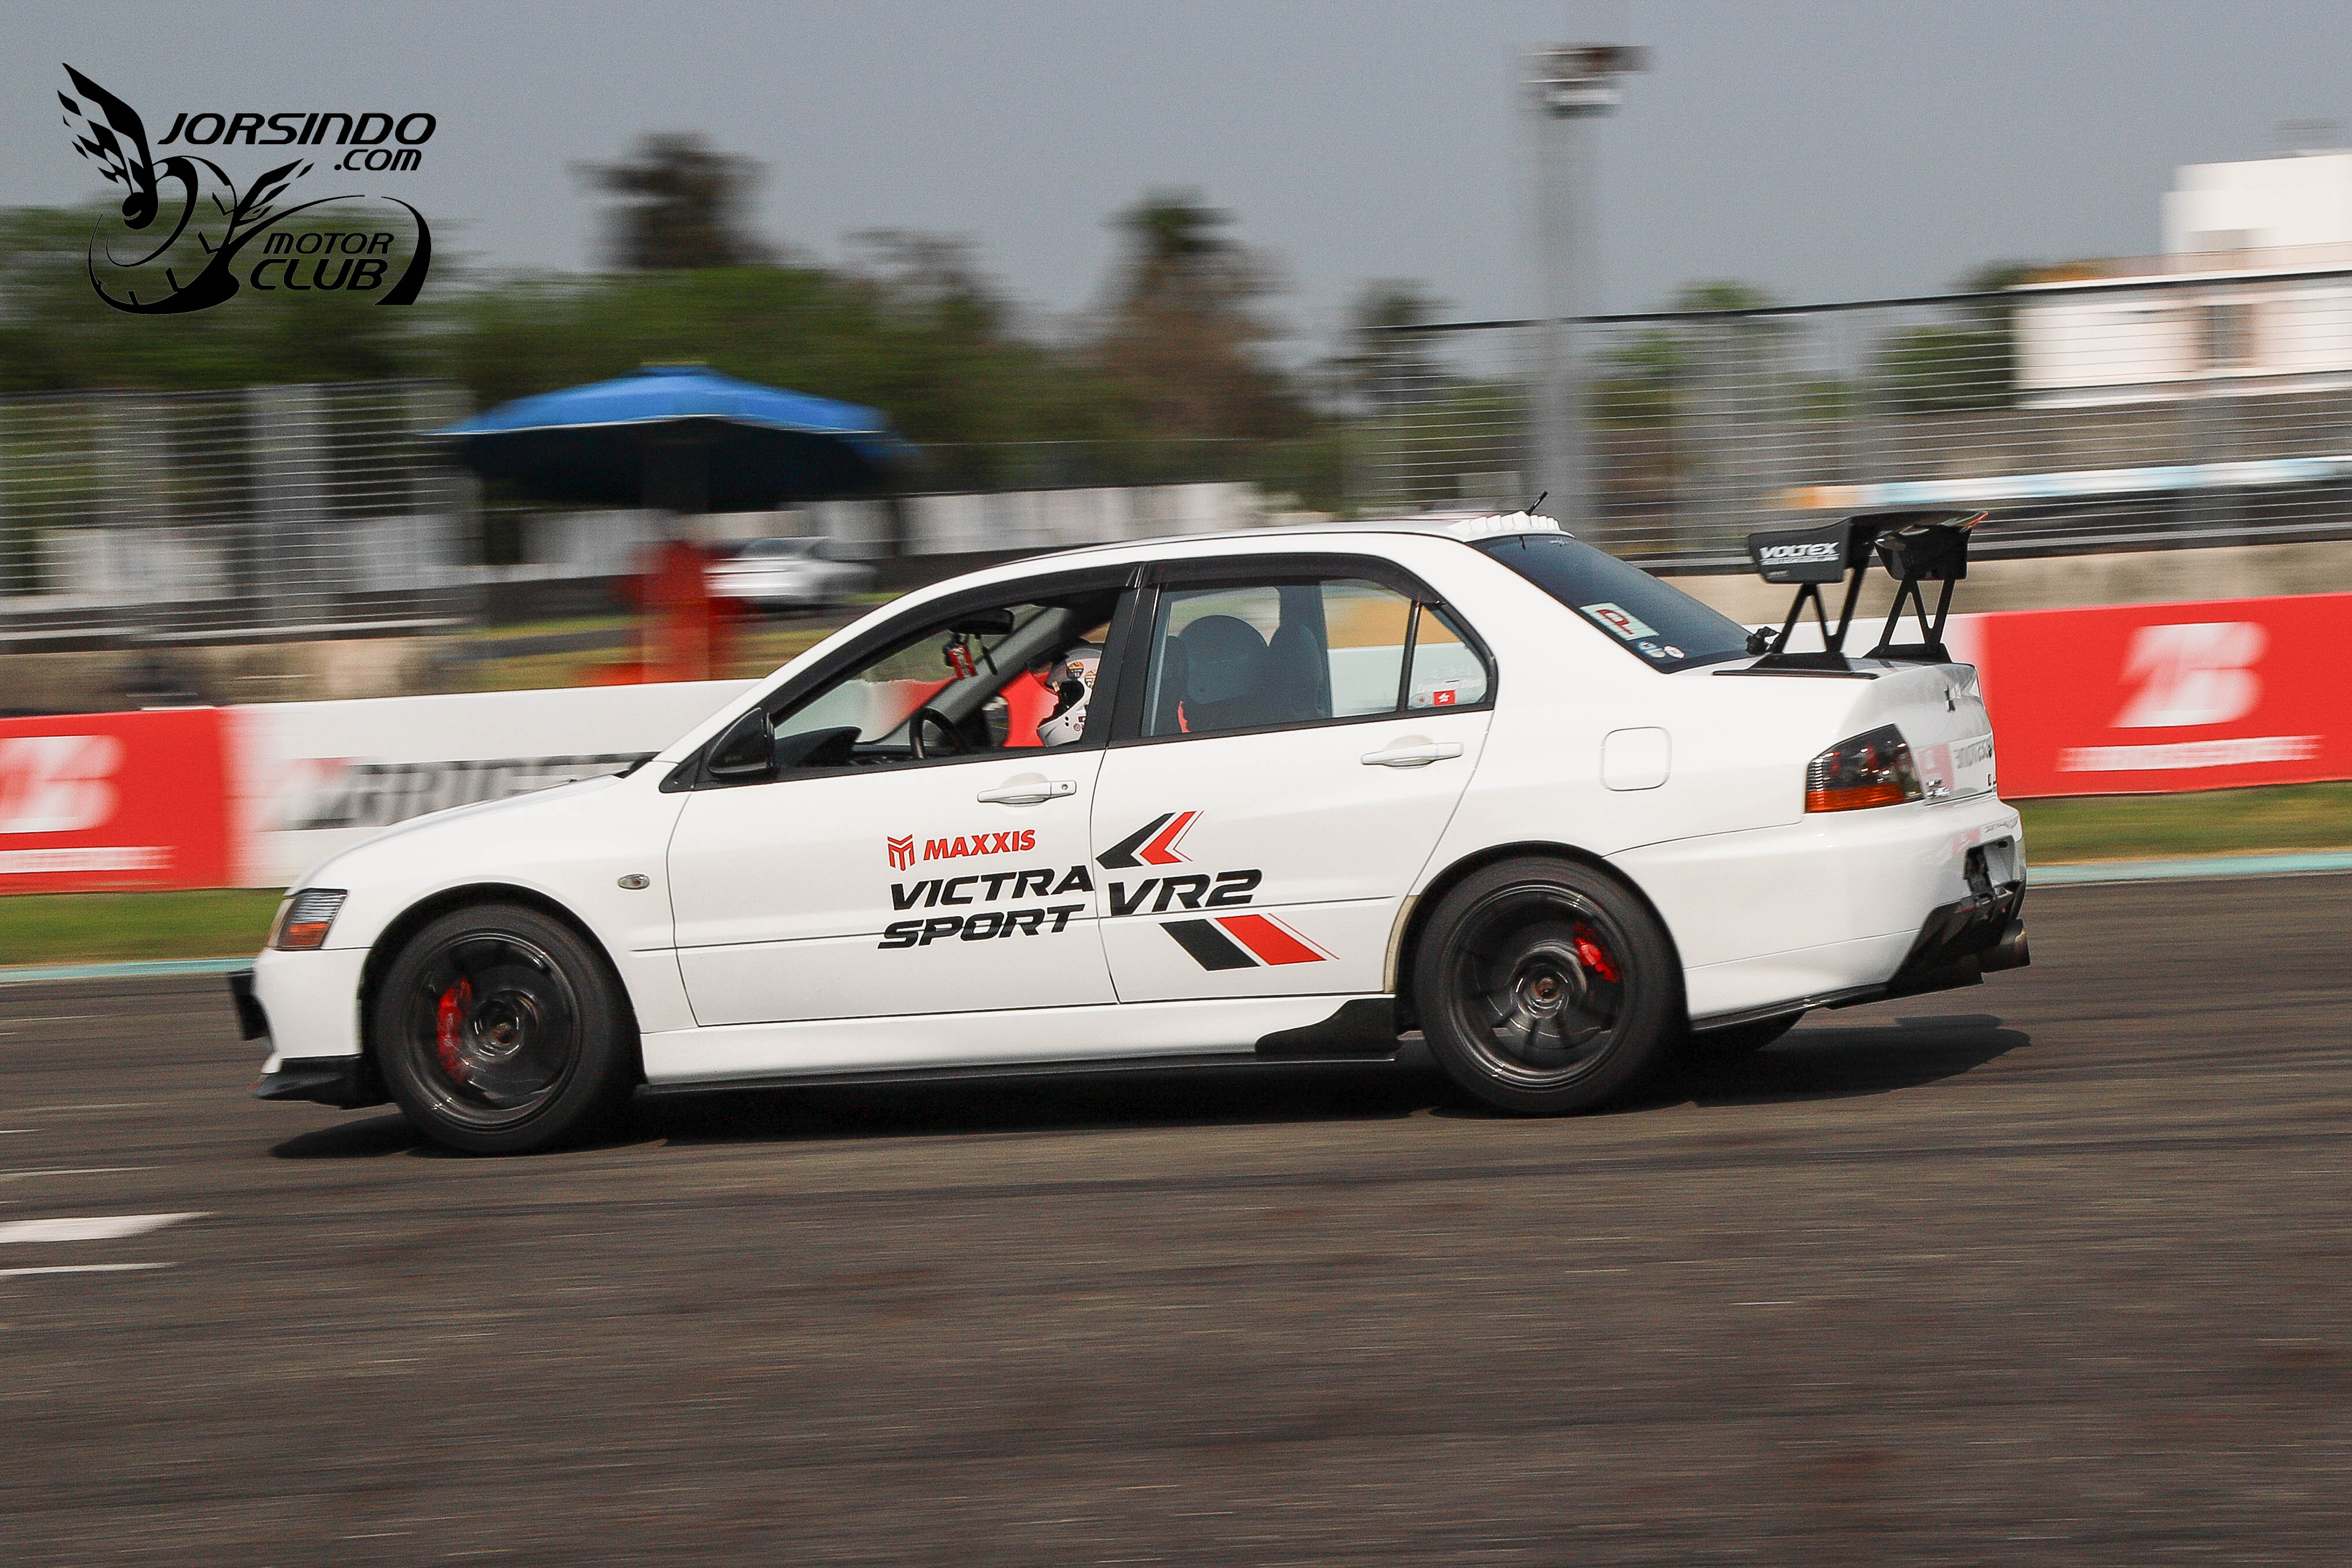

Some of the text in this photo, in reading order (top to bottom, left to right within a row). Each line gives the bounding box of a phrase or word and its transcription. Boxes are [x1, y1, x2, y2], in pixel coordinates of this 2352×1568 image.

[1759, 542, 1840, 559] VOLTEX
[924, 829, 1036, 861] MAXXIS
[890, 865, 1263, 916] VICTRA VR2
[877, 904, 1085, 949] SPORT
